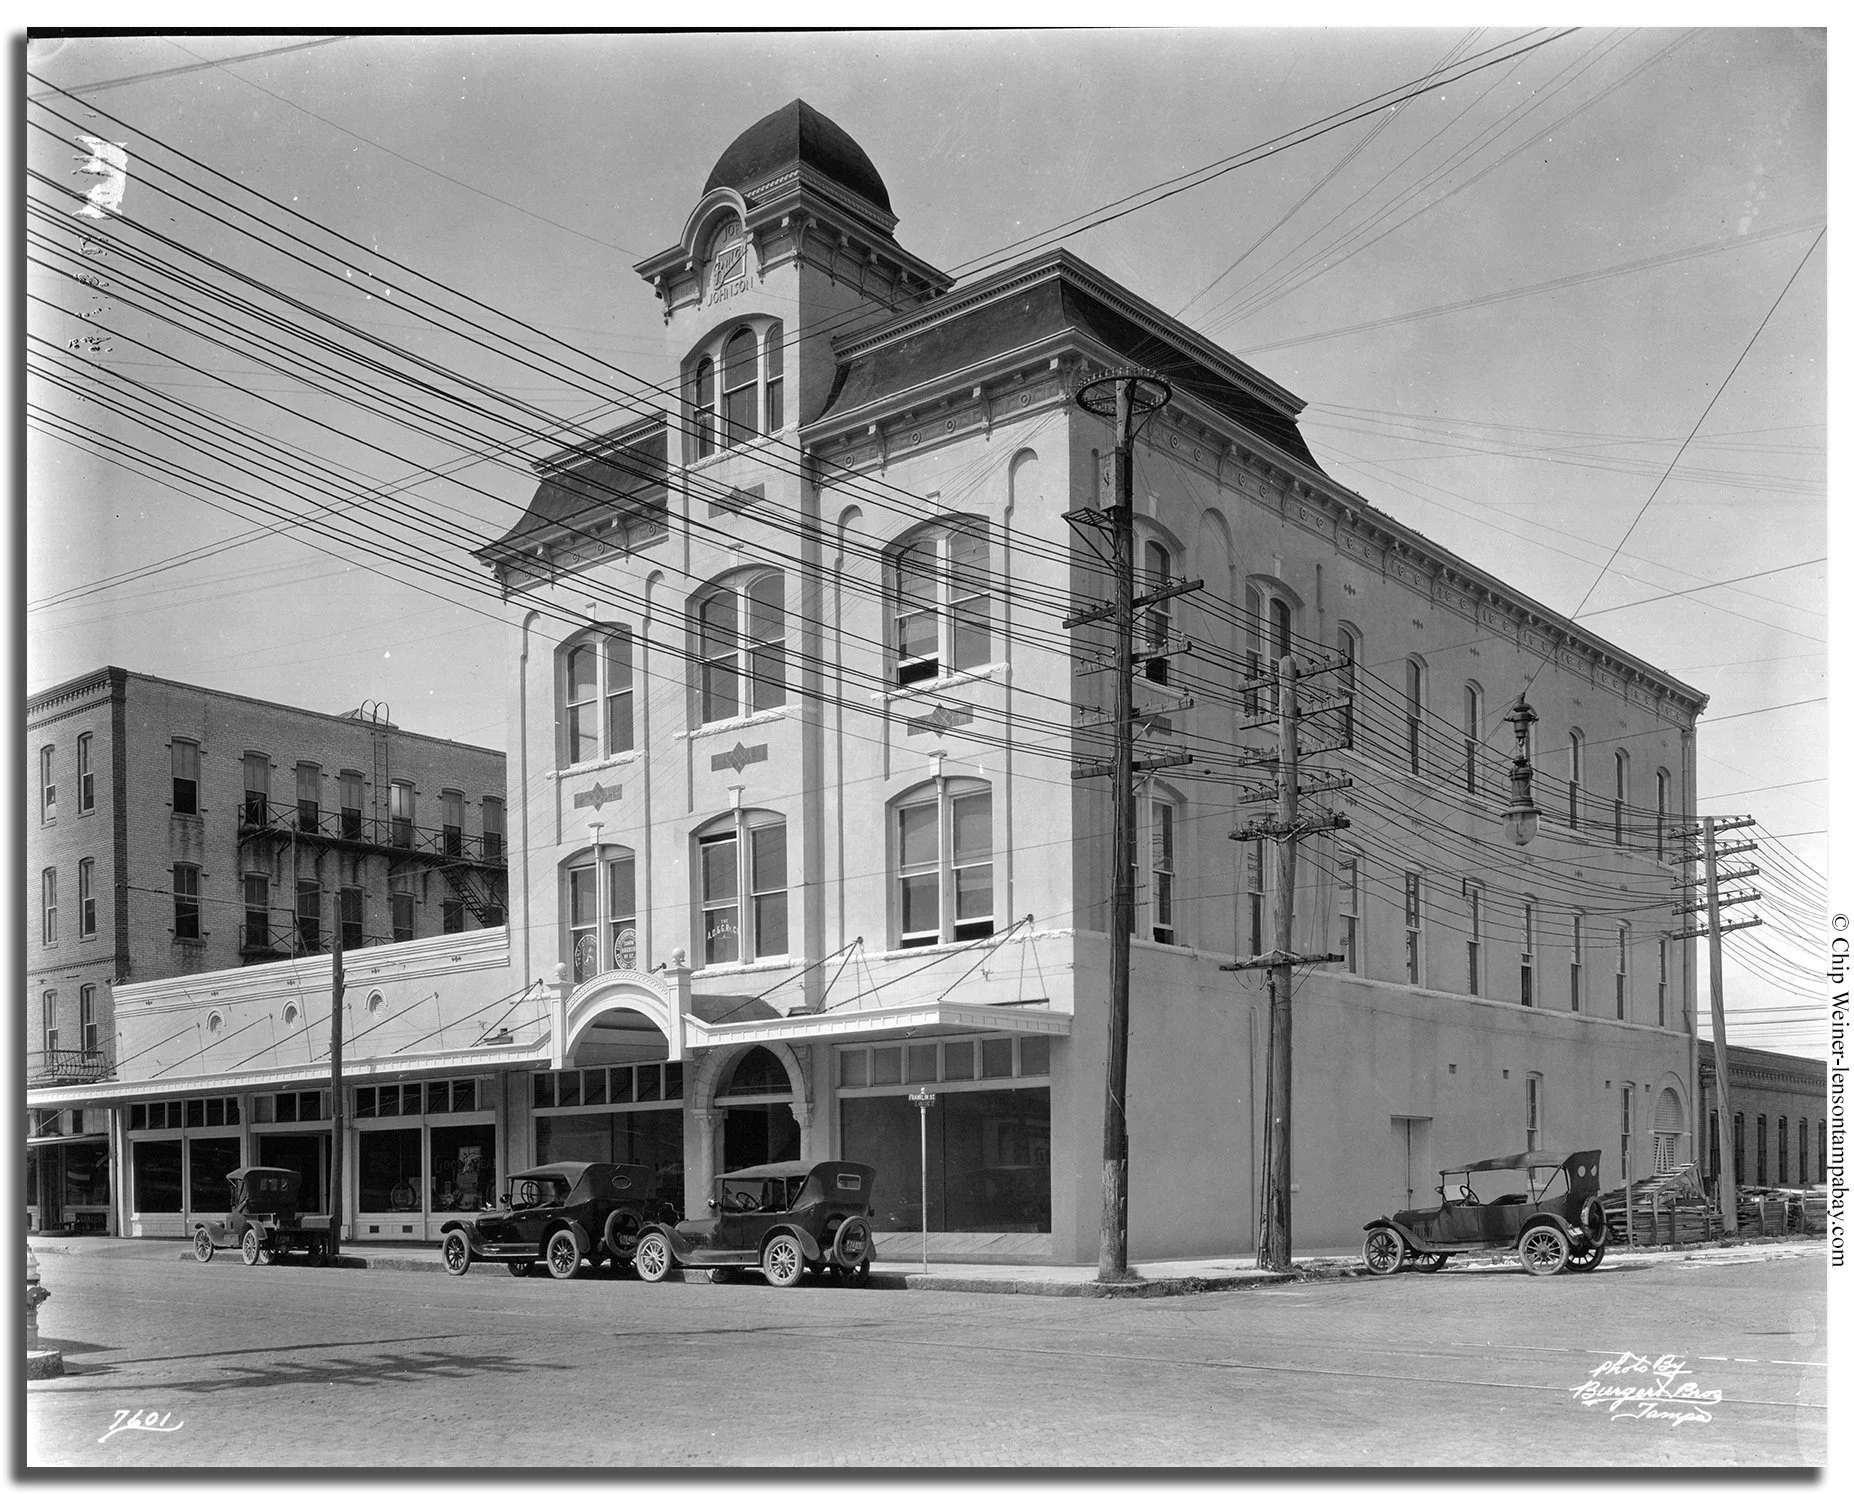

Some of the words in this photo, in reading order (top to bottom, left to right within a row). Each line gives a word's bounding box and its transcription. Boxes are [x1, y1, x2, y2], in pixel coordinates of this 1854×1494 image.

[707, 276, 754, 307] JOHNSON
[1569, 1378, 1673, 1411] Burgert
[105, 1408, 176, 1434] 7601
[1610, 1403, 1713, 1427] Tampa
